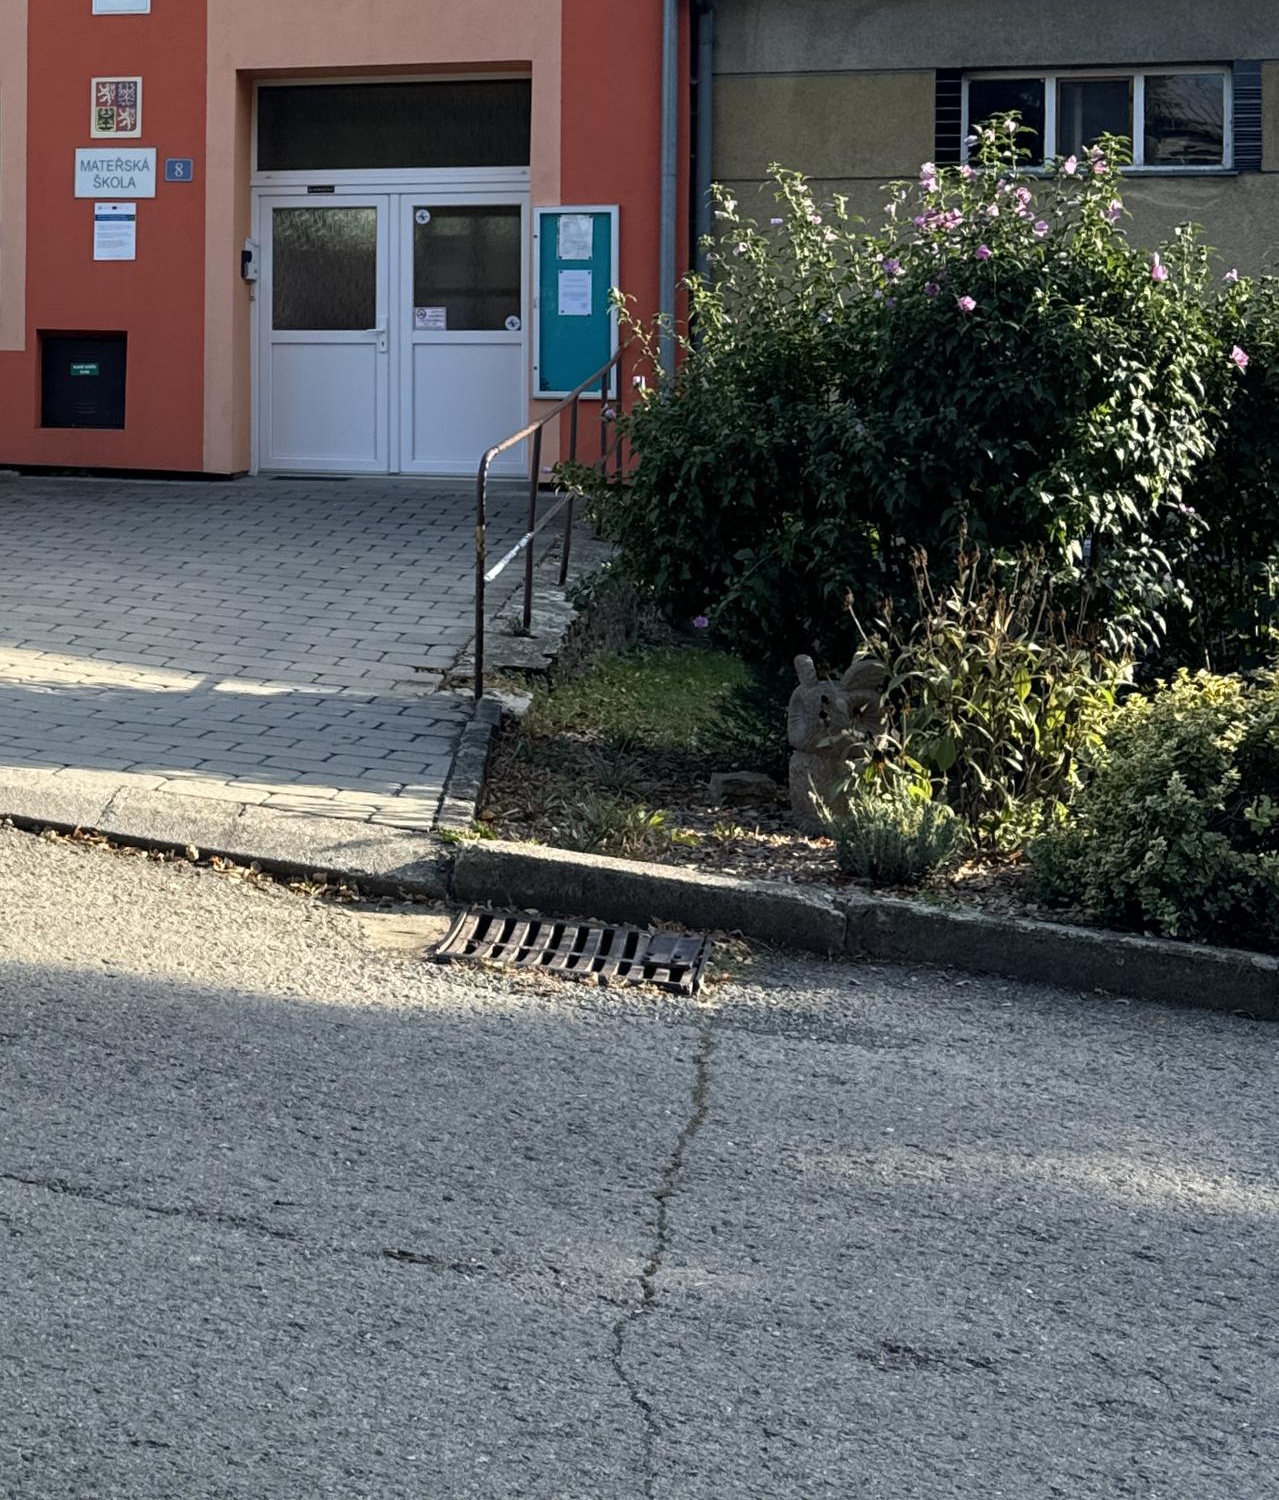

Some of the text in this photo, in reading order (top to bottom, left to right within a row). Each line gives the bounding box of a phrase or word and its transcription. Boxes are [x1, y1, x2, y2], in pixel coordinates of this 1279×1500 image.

[80, 156, 150, 172] MATEŘSKÁ
[174, 162, 184, 178] 8
[93, 174, 136, 189] ŠKOLA
